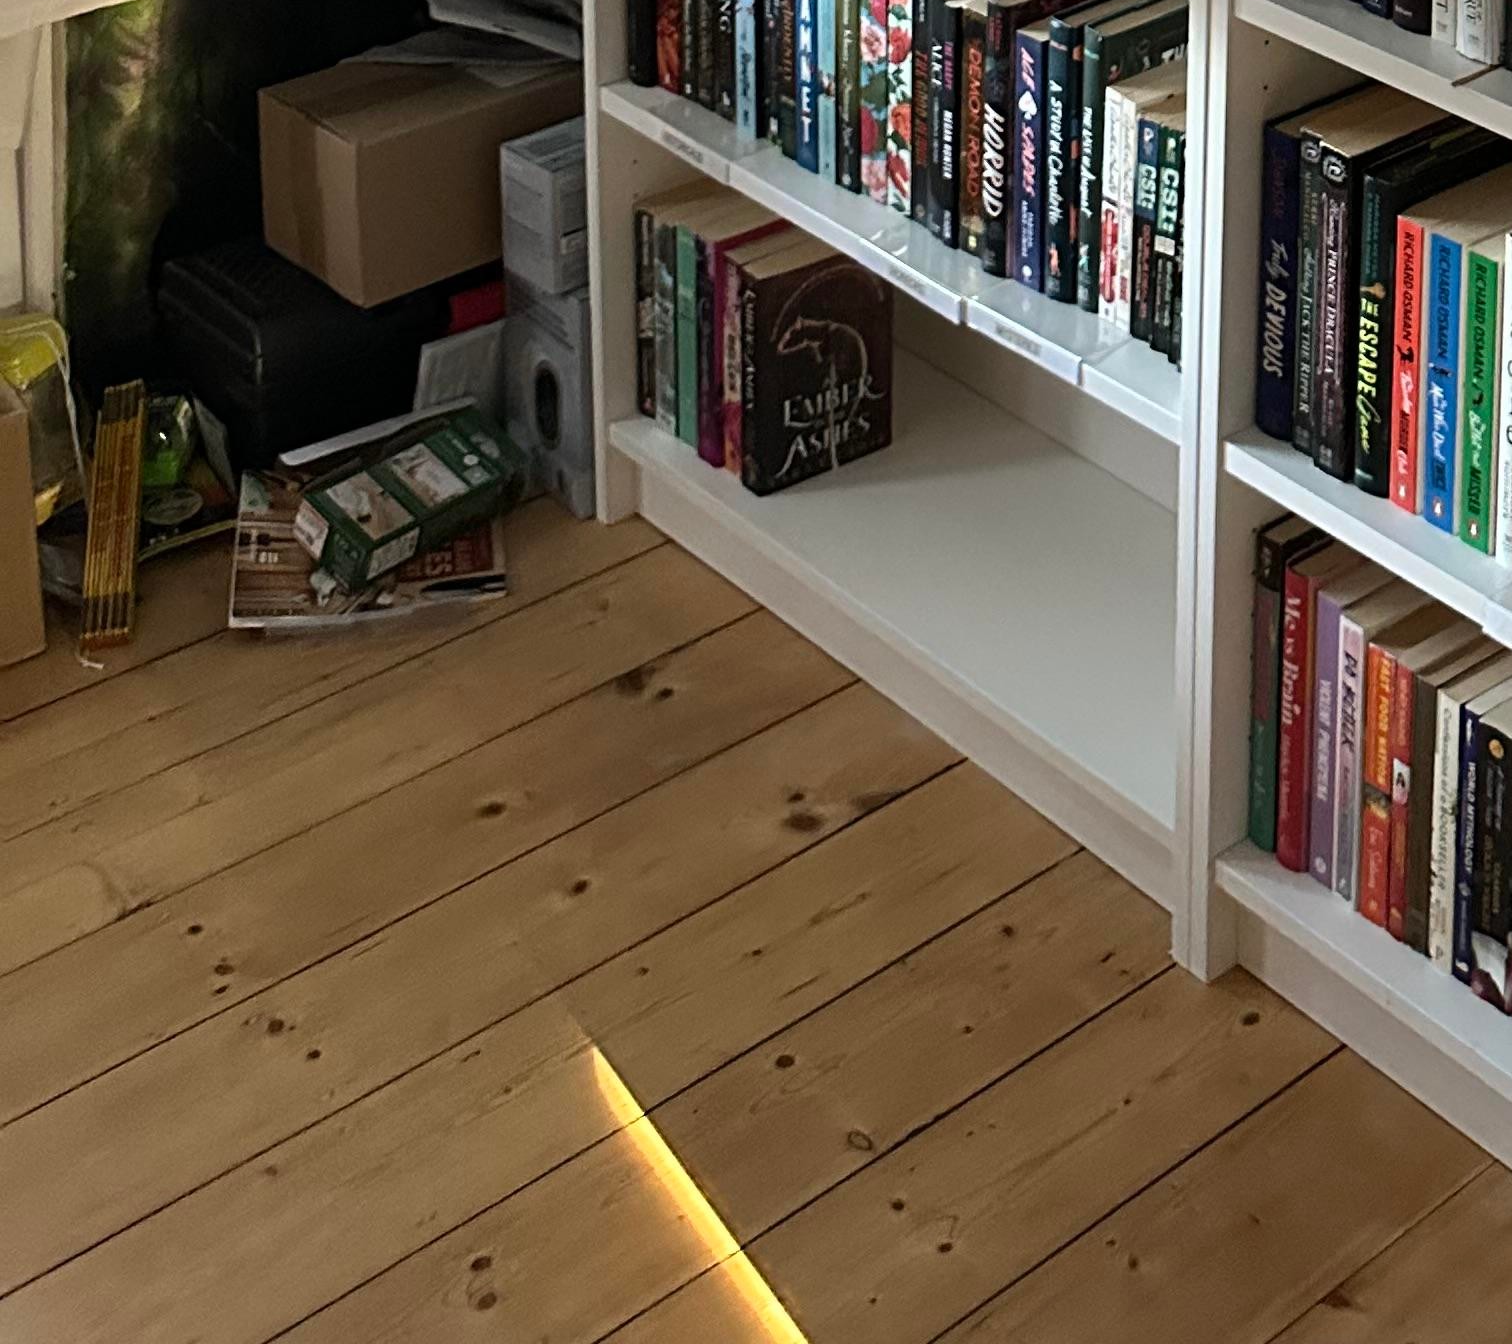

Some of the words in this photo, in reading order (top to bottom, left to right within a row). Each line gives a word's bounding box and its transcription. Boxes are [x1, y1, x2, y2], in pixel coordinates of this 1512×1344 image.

[981, 102, 1004, 218] HORRID
[1162, 166, 1179, 234] CSI:
[1472, 262, 1487, 323] RICHARD
[1261, 282, 1291, 378] DEVIOUS
[1357, 316, 1381, 396] ESCAPE
[1471, 325, 1486, 378] OSMAN
